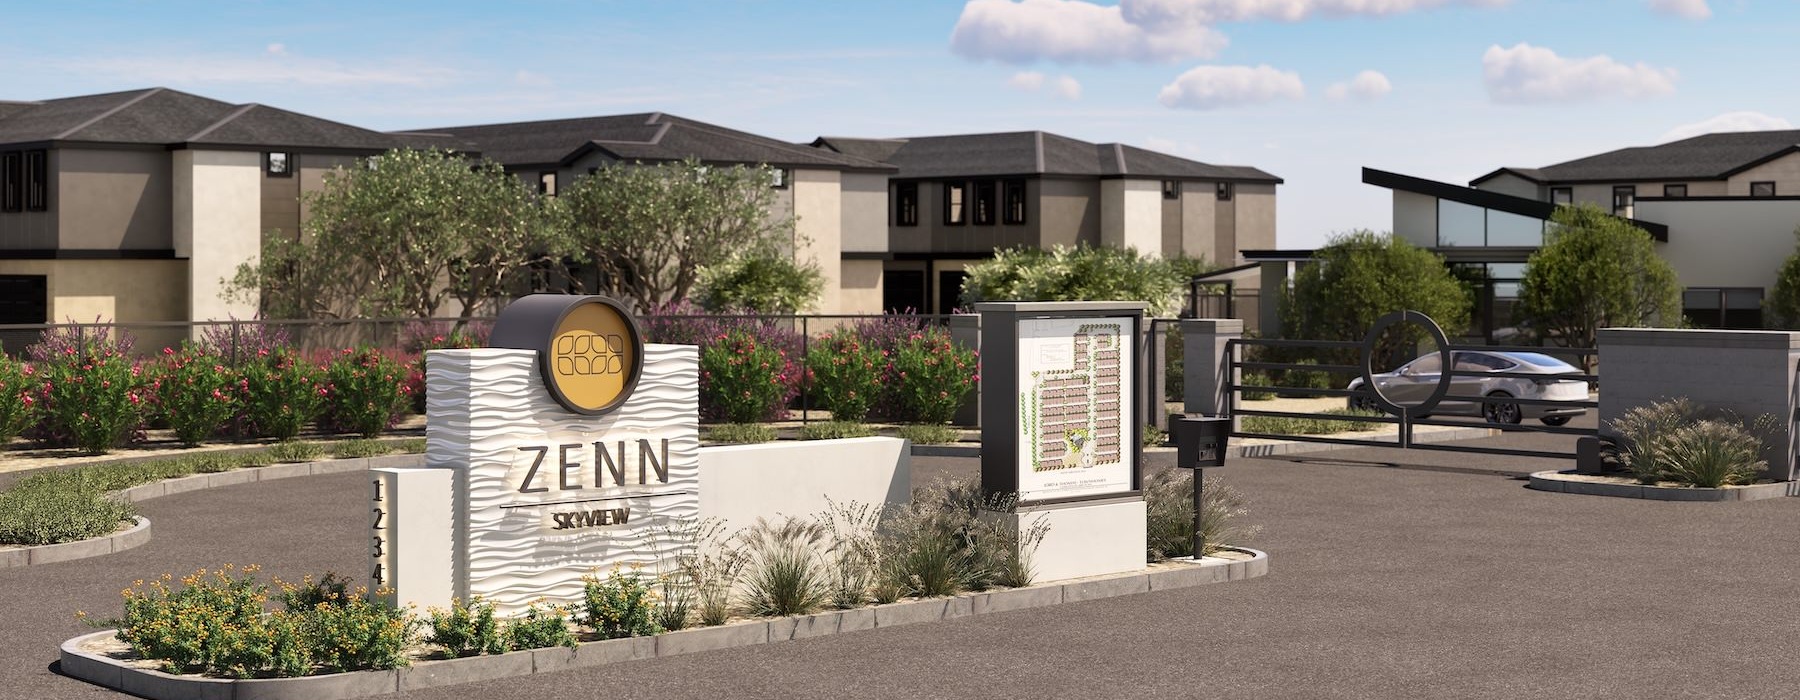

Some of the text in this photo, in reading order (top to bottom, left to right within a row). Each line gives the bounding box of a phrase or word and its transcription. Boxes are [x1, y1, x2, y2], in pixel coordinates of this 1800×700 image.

[517, 438, 669, 493] ZENN
[372, 479, 384, 585] 1234
[551, 507, 631, 530] SKYVIEW
